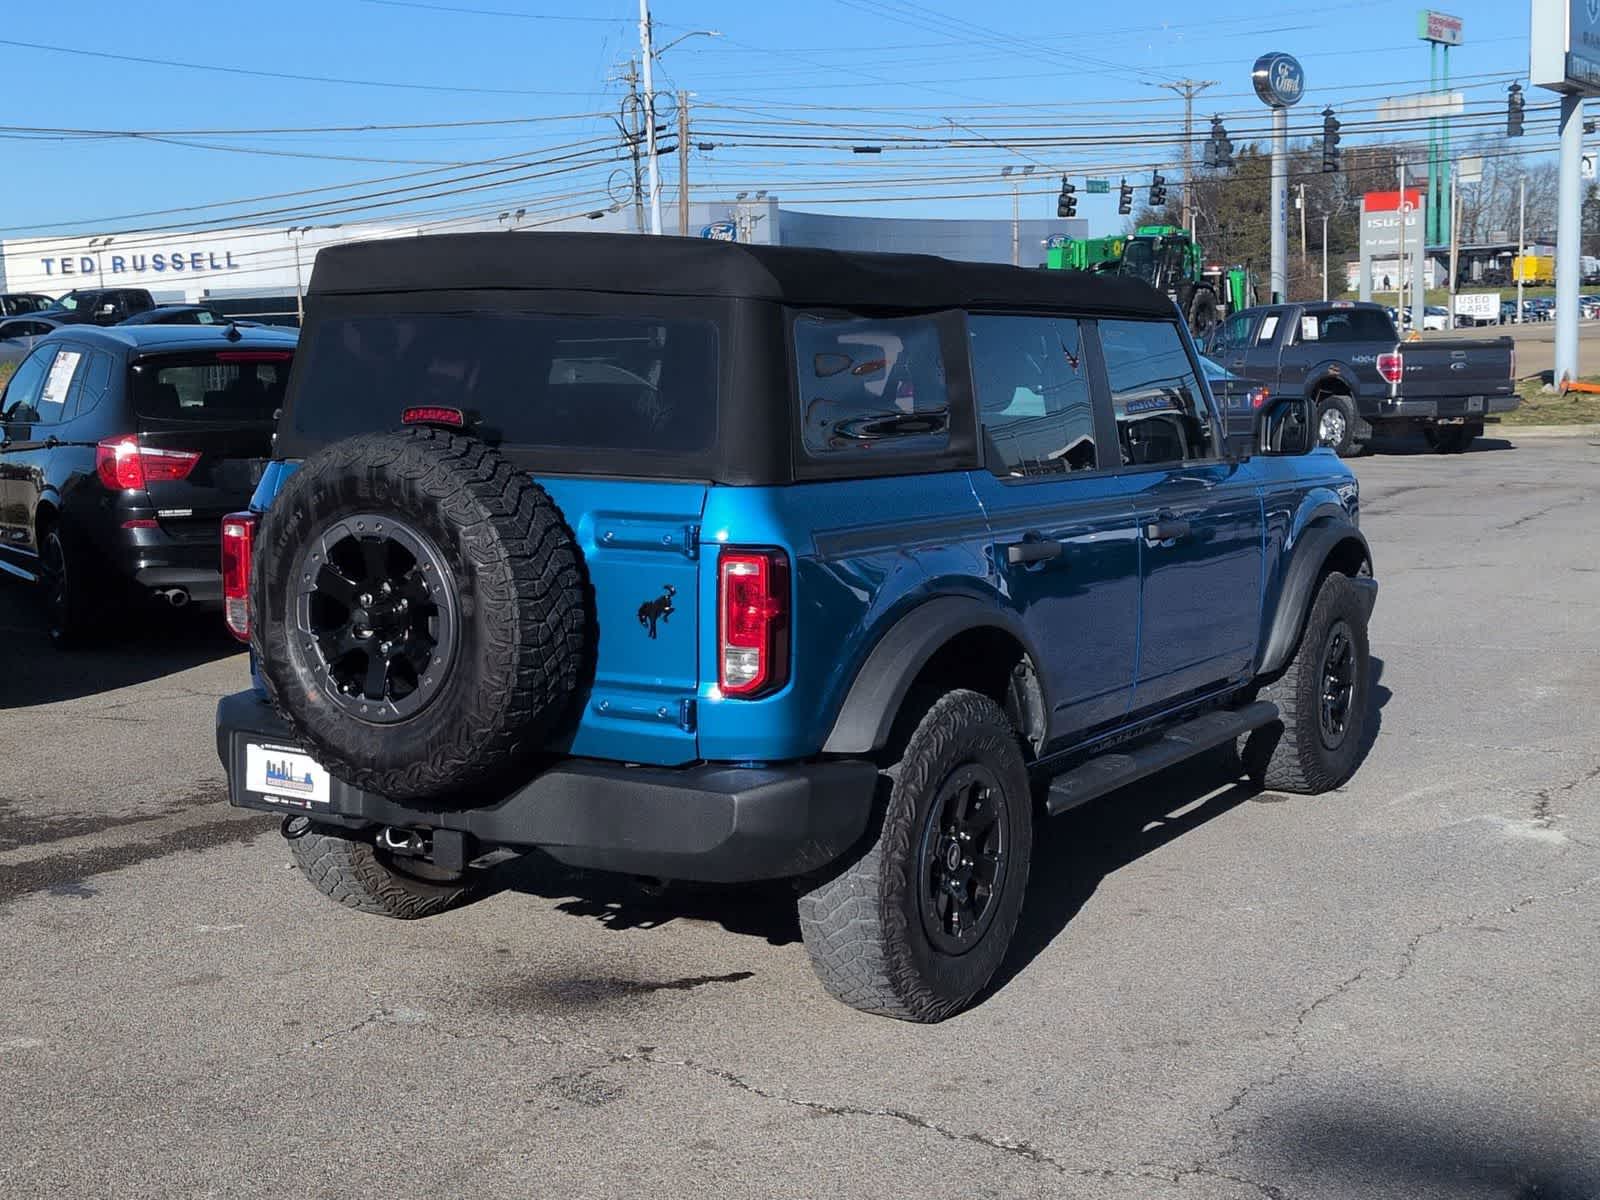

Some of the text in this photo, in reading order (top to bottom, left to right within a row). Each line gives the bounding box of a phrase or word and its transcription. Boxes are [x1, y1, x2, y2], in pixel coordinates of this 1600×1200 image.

[1276, 62, 1300, 93] Ford
[1367, 217, 1416, 228] ISUZU
[708, 225, 734, 241] Ford
[41, 251, 240, 275] TED RUSSELL
[1458, 296, 1489, 304] USED
[1459, 305, 1490, 313] CARS
